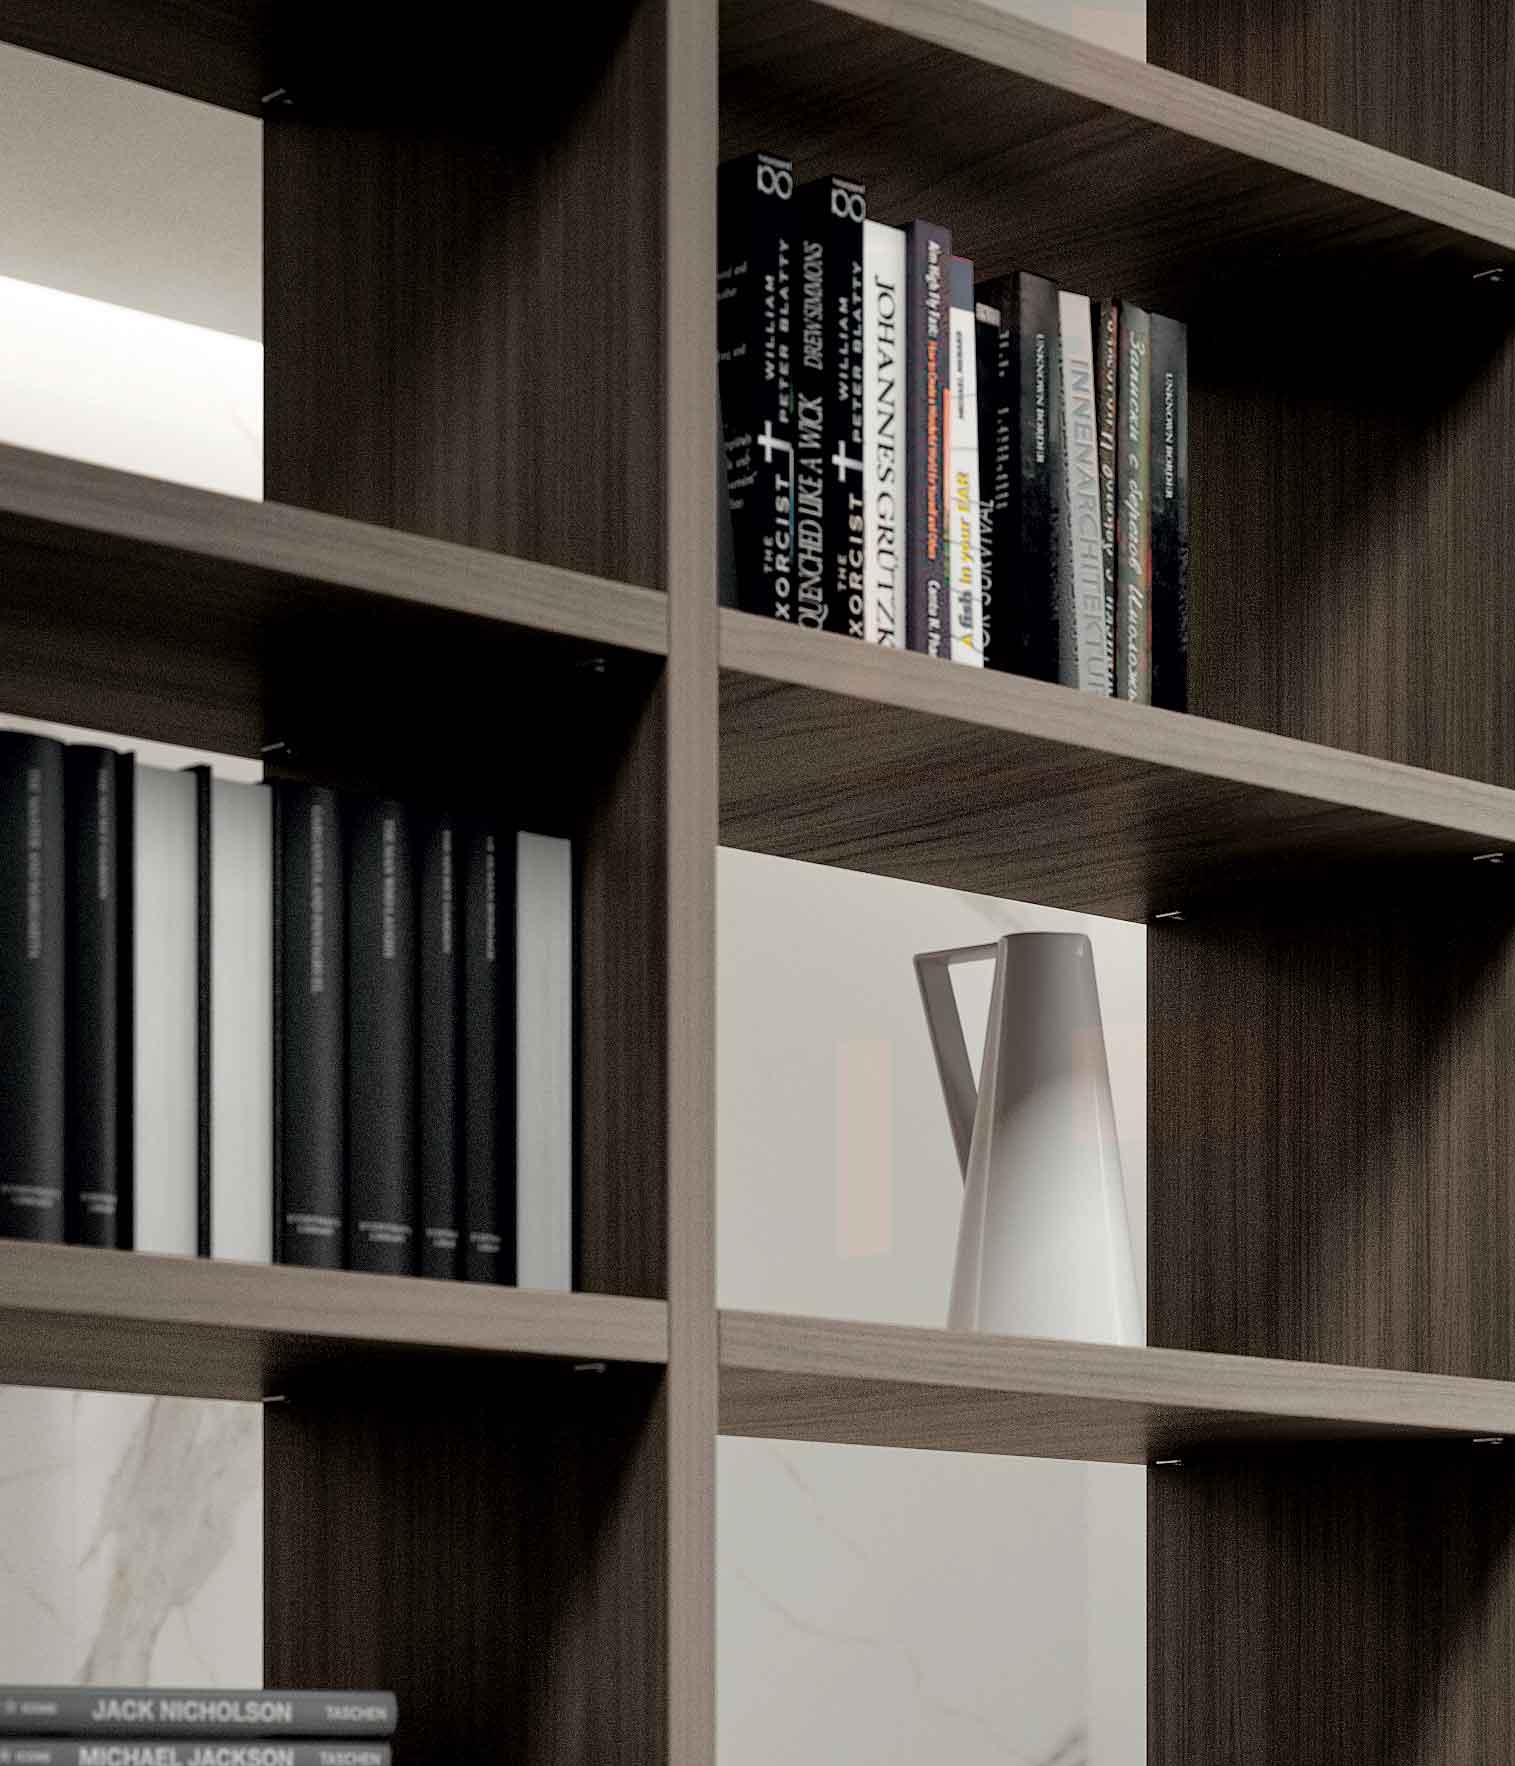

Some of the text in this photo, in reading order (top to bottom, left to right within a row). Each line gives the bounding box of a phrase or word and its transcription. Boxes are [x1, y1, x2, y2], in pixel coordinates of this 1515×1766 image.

[764, 274, 776, 381] WILLIAM
[777, 236, 791, 424] PETER BLATTY
[798, 391, 824, 450] WICK
[798, 474, 824, 518] LIKE
[763, 535, 775, 574] THE
[798, 521, 829, 630] QUENCHED
[92, 1698, 293, 1723] JACK NICHOLSON
[324, 1704, 388, 1722] TASCHEN
